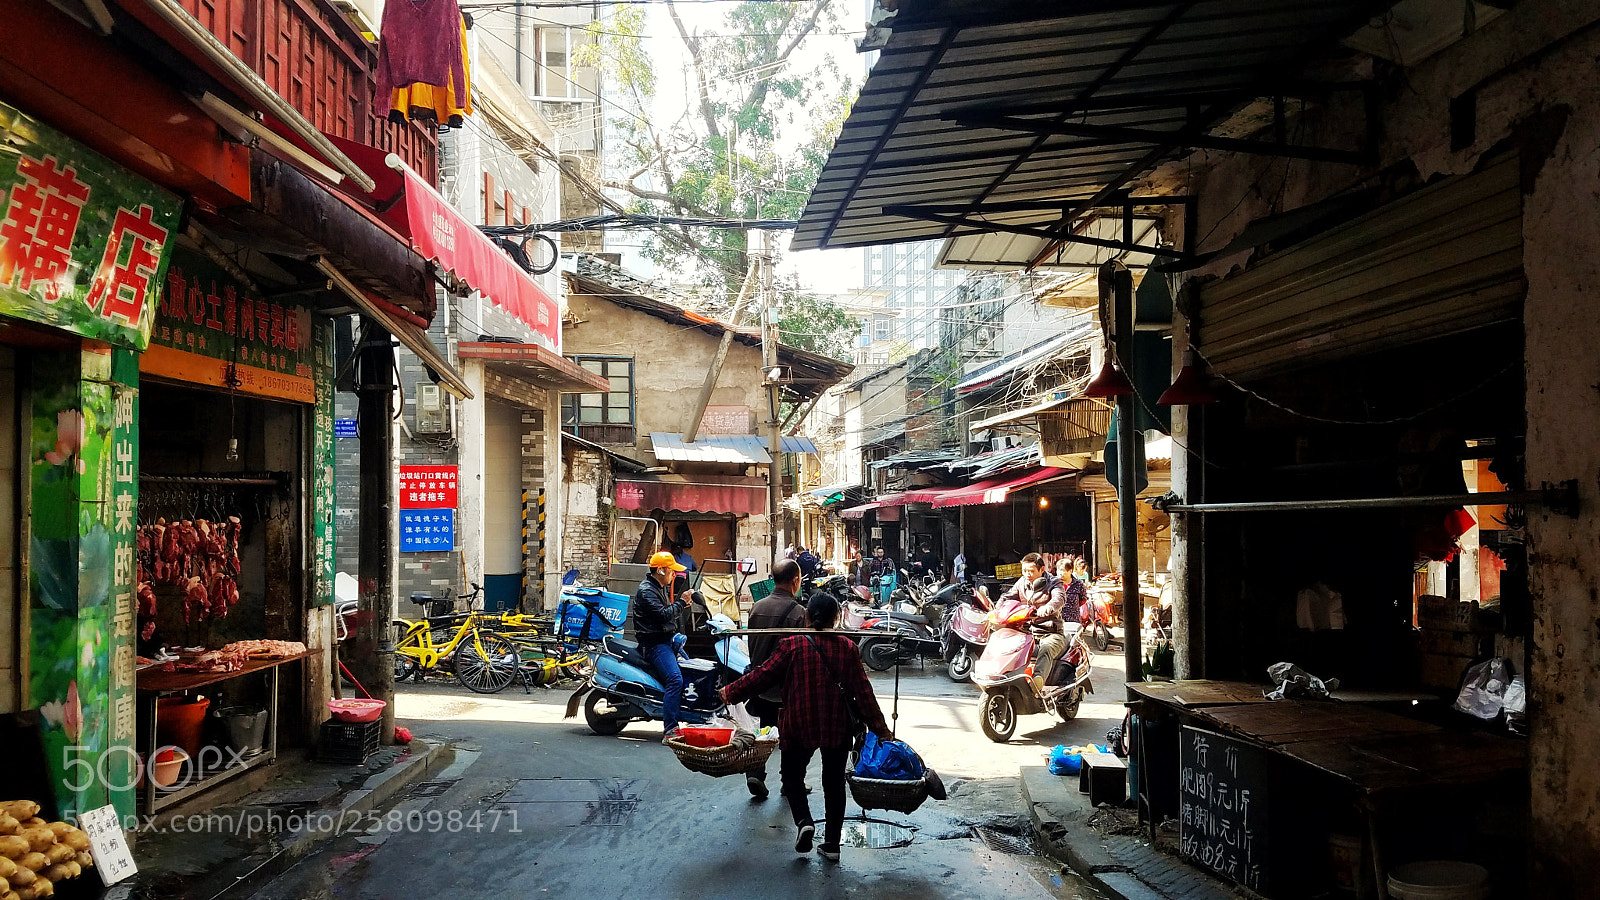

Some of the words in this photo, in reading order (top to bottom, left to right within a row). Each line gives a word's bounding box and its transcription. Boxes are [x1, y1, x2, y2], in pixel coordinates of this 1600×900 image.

[0, 153, 169, 330] 藕店
[160, 266, 298, 353] 放心土猪肉专卖店
[400, 482, 456, 490] 禁止停放车辆
[409, 492, 446, 502] 违者拖车
